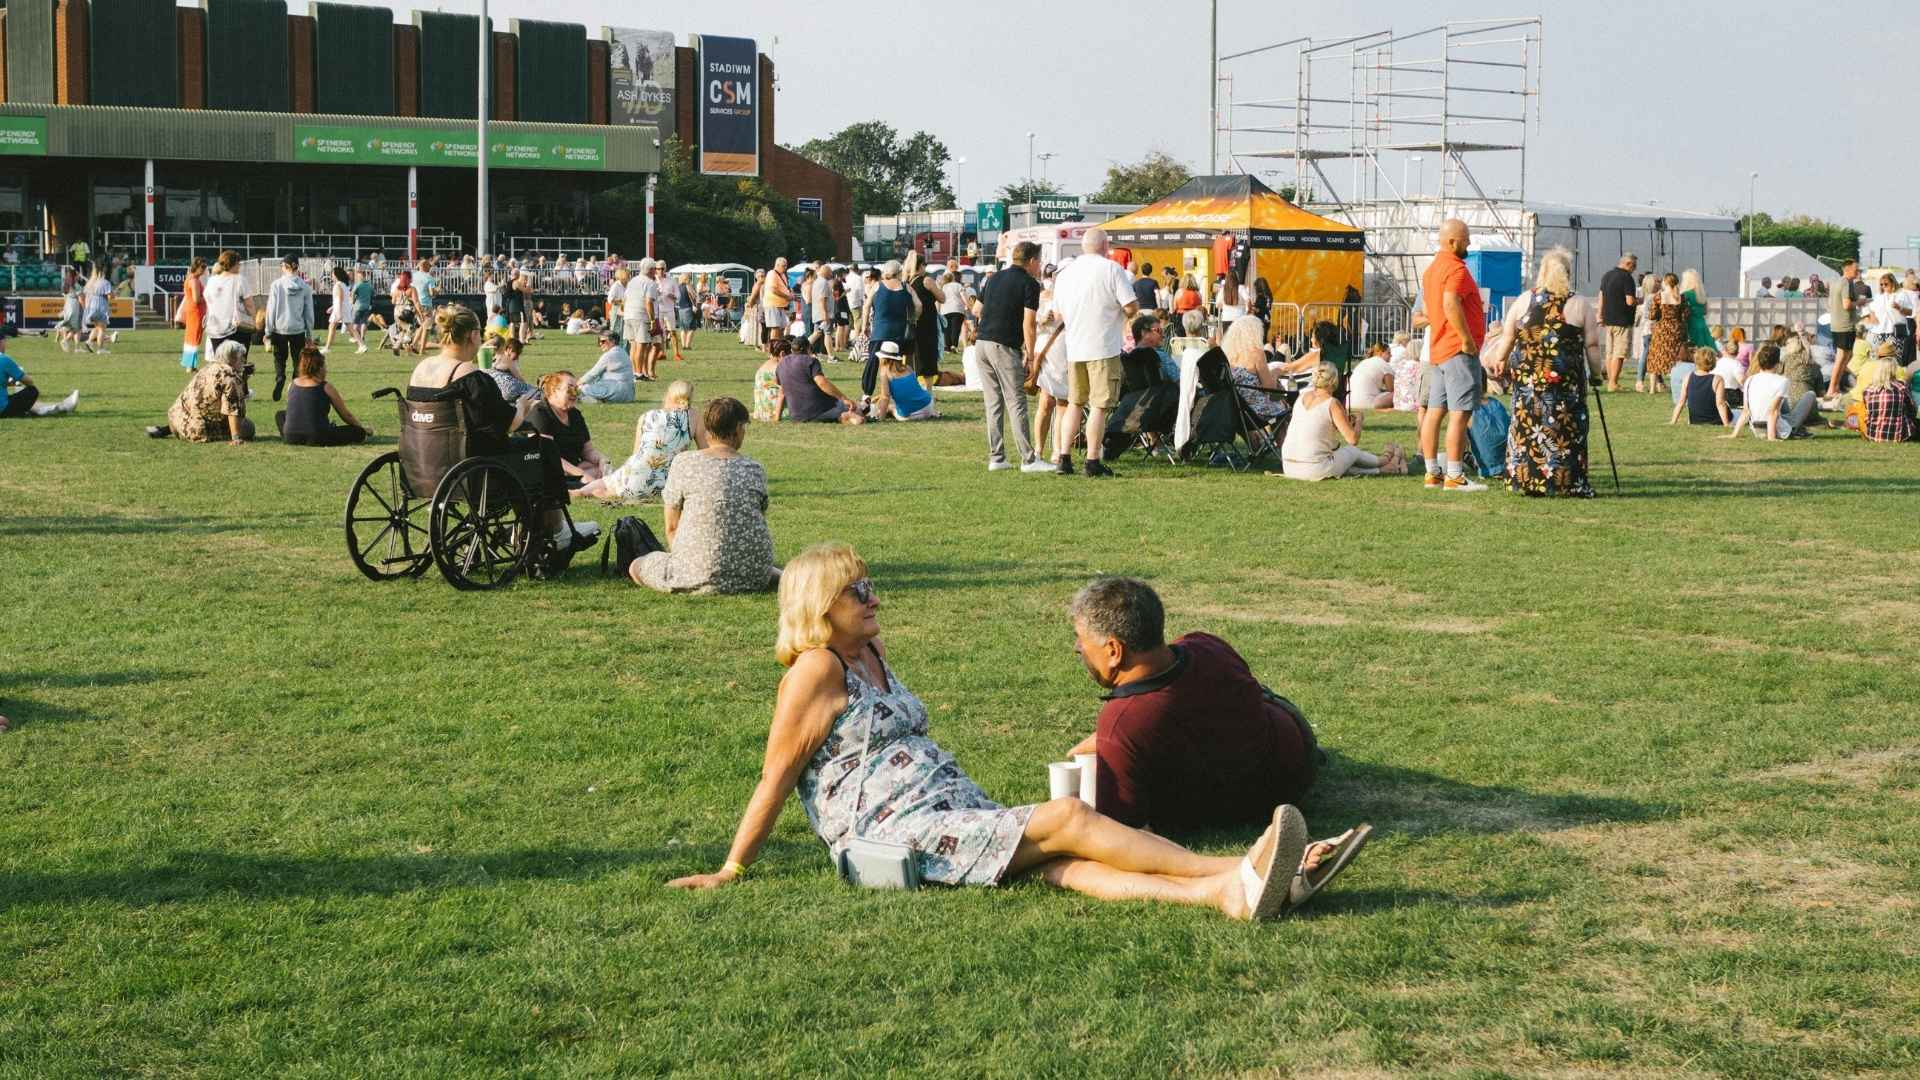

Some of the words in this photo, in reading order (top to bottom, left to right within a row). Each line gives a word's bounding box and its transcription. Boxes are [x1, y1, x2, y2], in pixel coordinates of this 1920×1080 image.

[709, 62, 751, 74] STADIWM
[617, 90, 638, 101] ASH
[641, 92, 671, 103] DYKES
[709, 79, 751, 105] CSM
[1036, 200, 1080, 210] TOILEDAU
[158, 274, 185, 282] STADI
[411, 410, 434, 423] drive
[523, 452, 541, 461] drive
